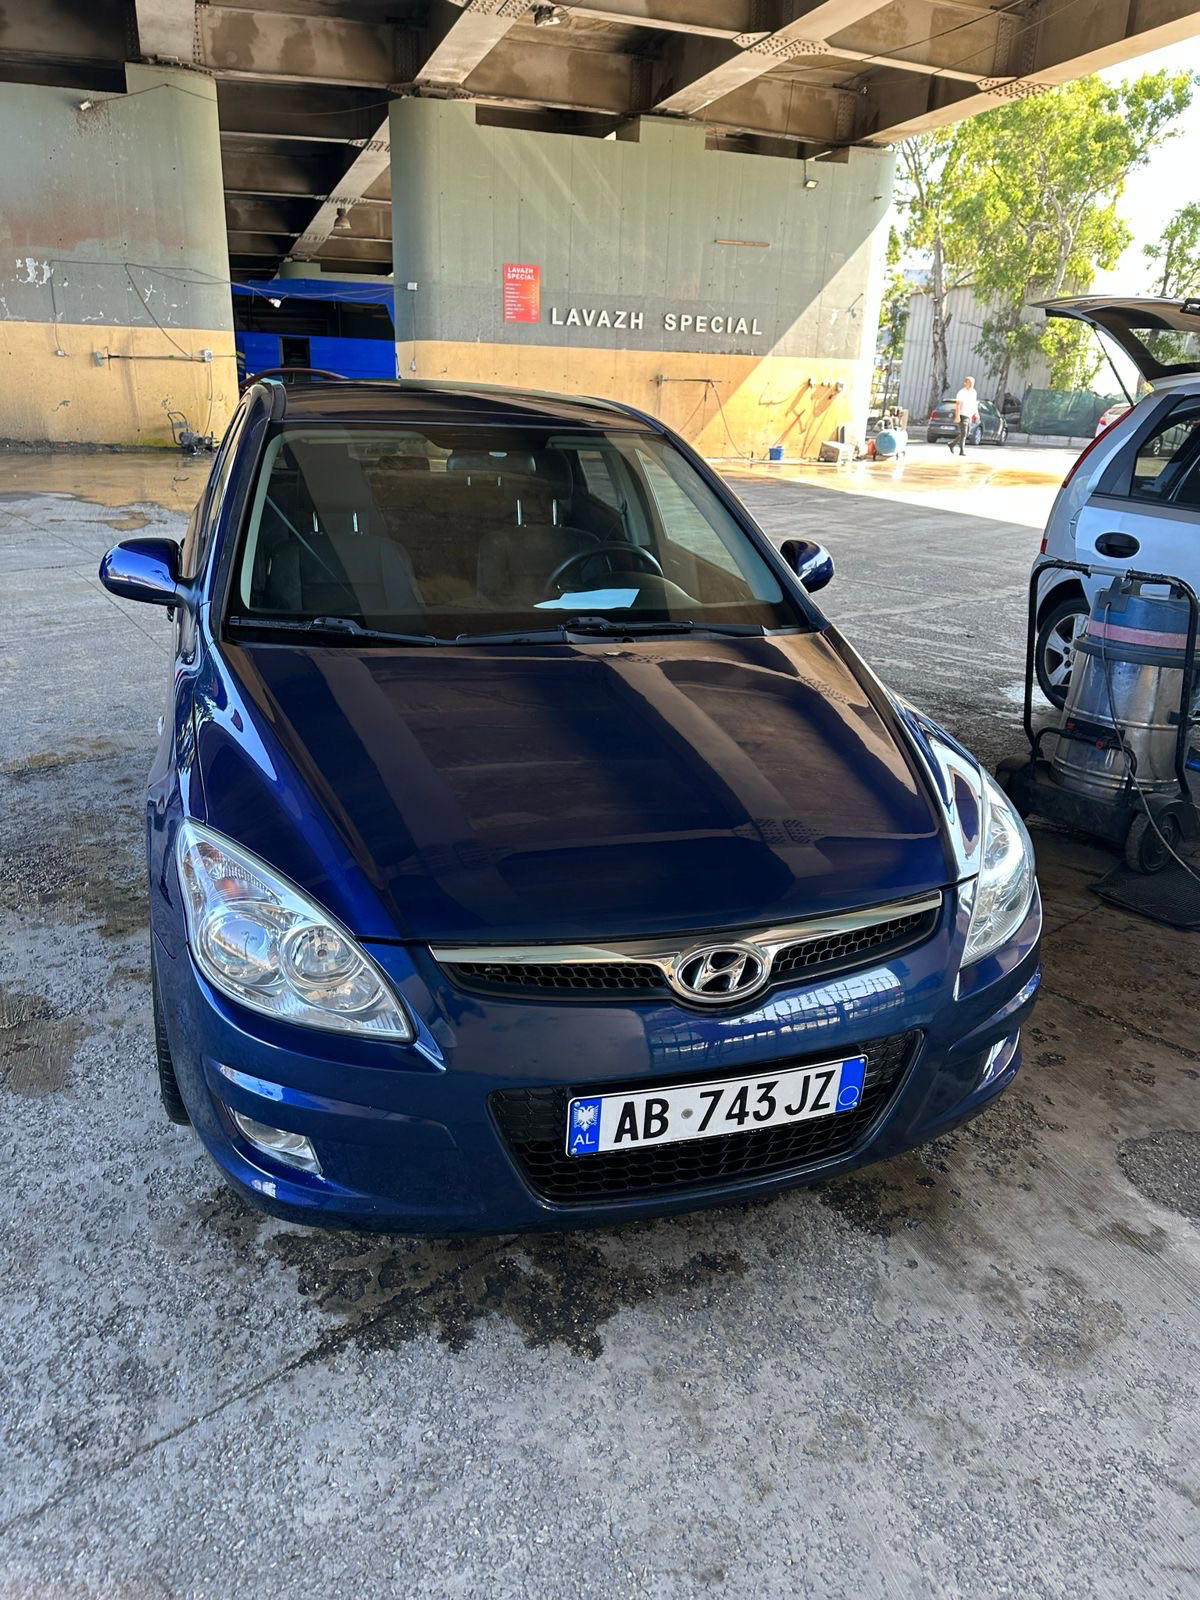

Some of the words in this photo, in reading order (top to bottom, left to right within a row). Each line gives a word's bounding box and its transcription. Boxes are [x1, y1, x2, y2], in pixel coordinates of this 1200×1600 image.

[551, 307, 644, 330] LAVAZH
[664, 313, 763, 336] SPECIAL
[613, 1098, 670, 1143] AB
[697, 1081, 780, 1132] 743
[784, 1069, 837, 1115] JZ
[573, 1132, 596, 1145] AL
